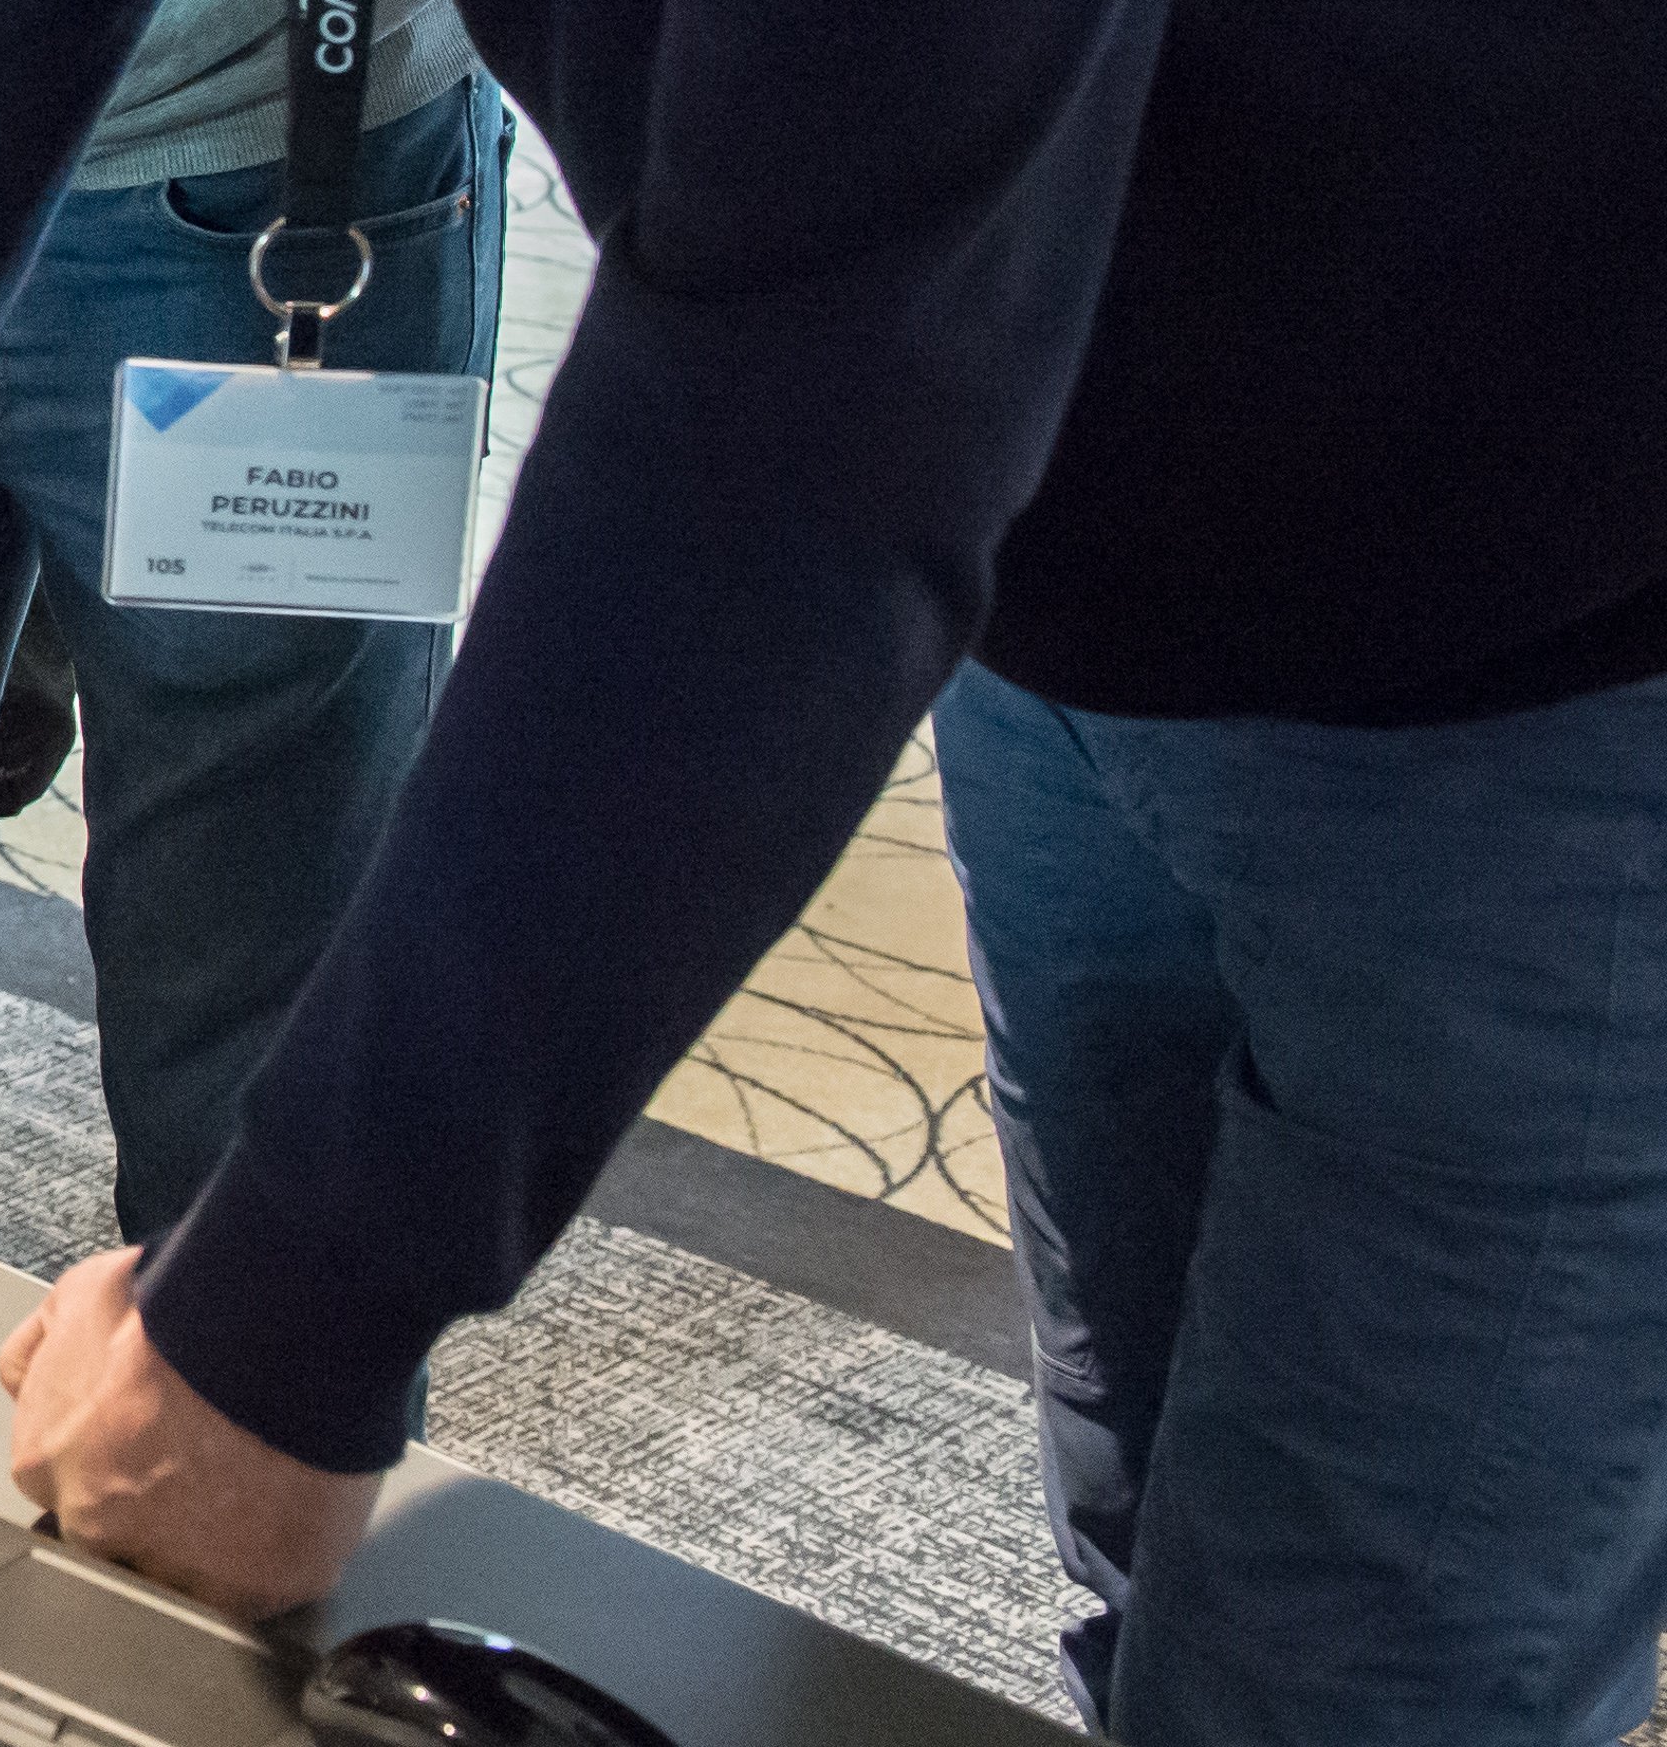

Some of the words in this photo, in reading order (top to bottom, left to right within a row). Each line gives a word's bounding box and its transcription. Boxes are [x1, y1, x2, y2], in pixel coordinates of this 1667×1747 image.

[246, 465, 340, 491] FABIO
[210, 495, 370, 522] PERUZZINI
[201, 519, 276, 536] TELECOM
[279, 524, 331, 538] ITALIA
[146, 557, 187, 575] 105
